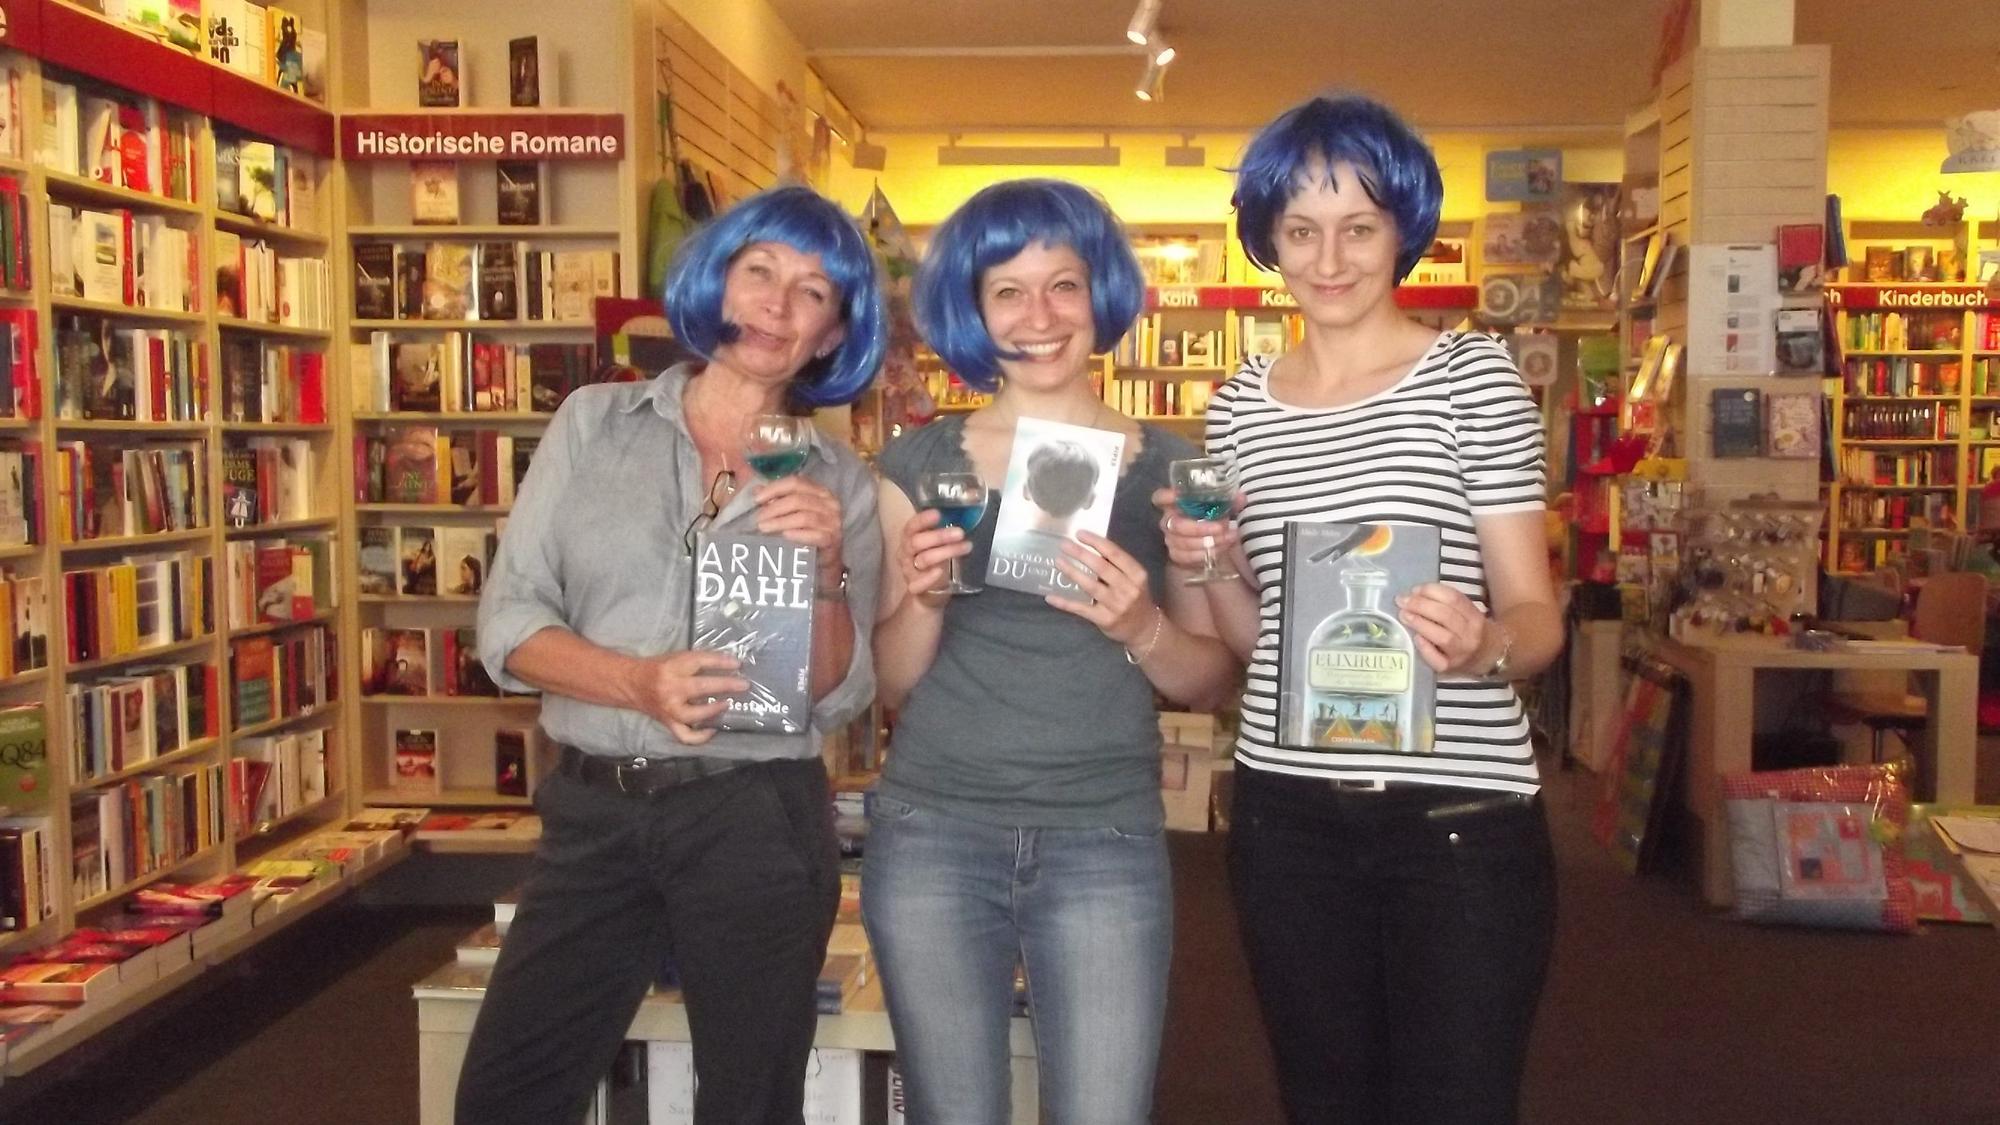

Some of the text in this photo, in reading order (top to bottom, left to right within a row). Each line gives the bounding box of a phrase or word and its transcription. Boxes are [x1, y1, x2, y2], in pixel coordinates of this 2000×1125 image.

[357, 131, 617, 154] Historische Romane
[1879, 290, 1988, 306] Kinderbuch
[699, 542, 809, 578] ARNE
[992, 557, 1028, 579] DU
[1048, 567, 1080, 591] IC
[696, 572, 809, 609] DAHL
[1315, 653, 1404, 670] ELIXIRIUM
